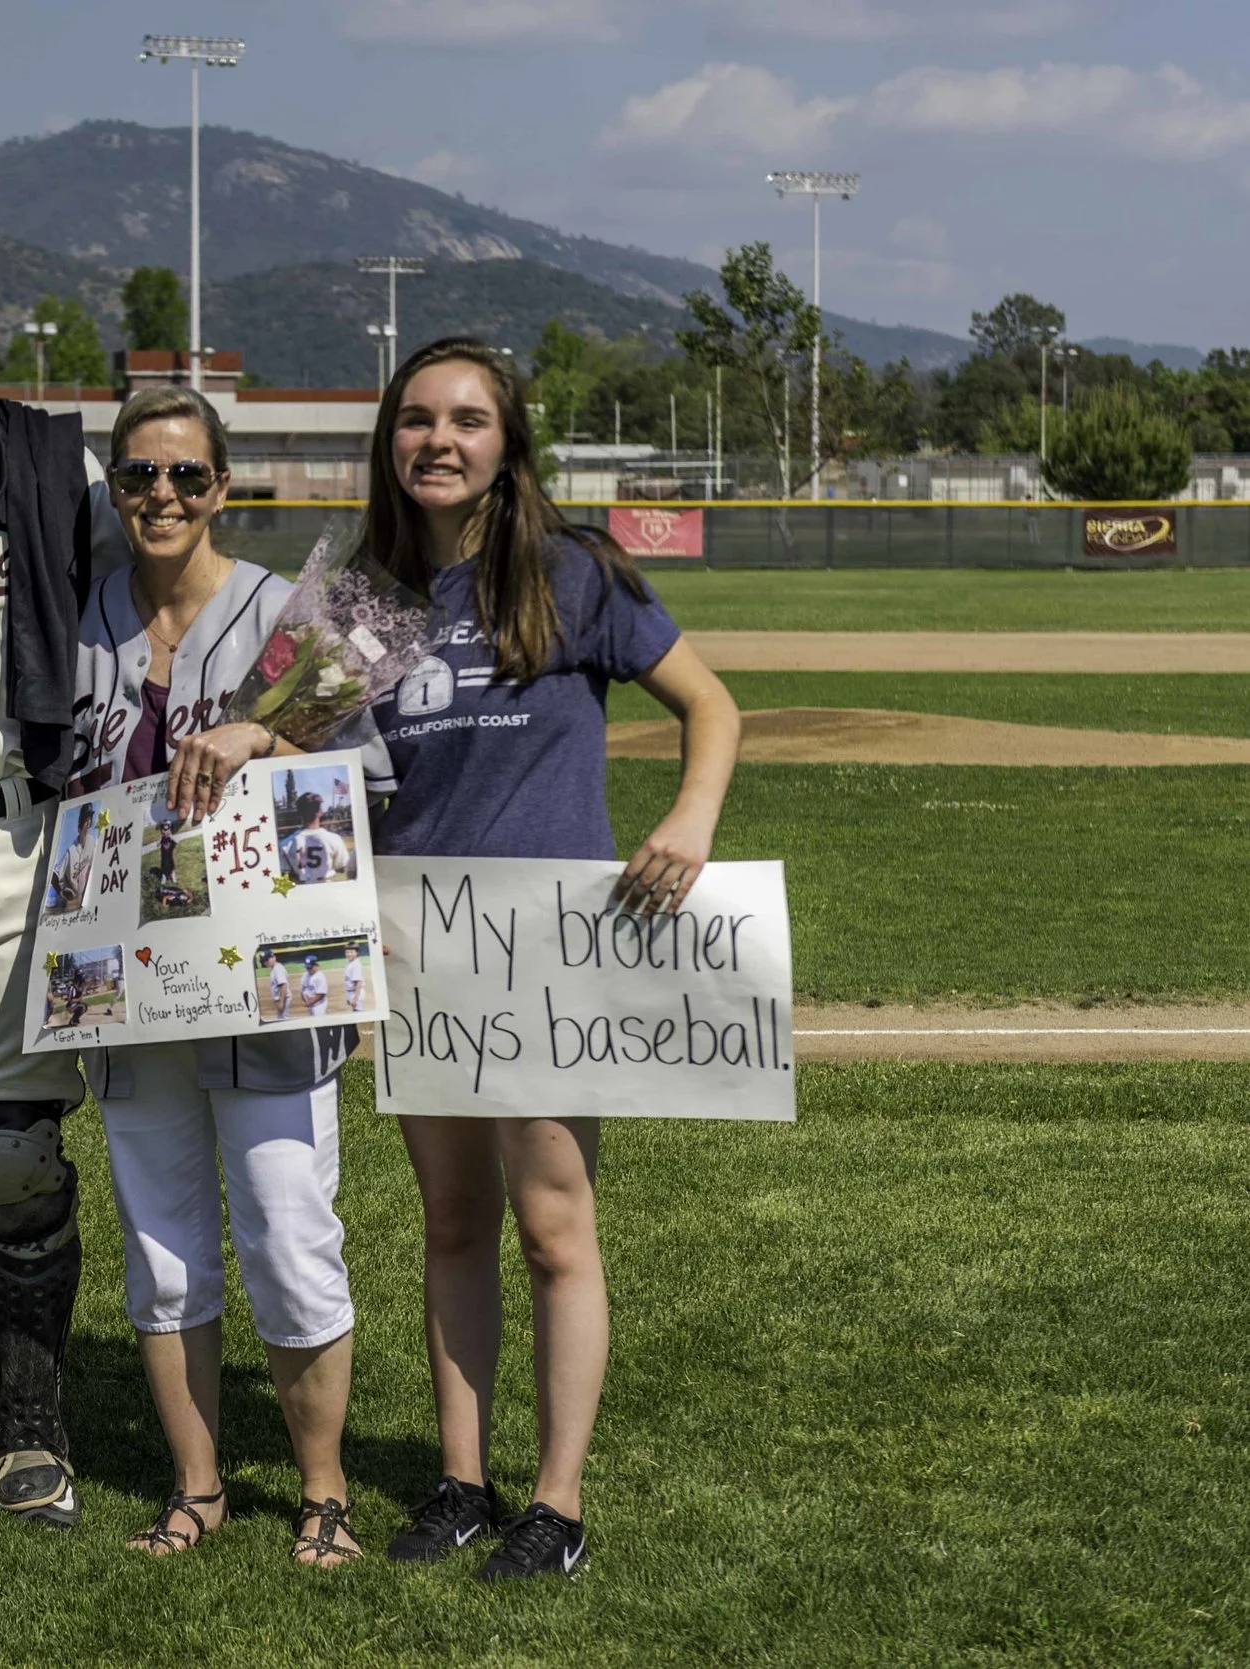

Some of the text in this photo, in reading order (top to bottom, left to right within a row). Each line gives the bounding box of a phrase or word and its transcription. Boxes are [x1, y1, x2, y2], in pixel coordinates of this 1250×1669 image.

[422, 682, 429, 706] 1
[399, 716, 476, 738] CALIFORNIA
[478, 713, 531, 727] COAST
[101, 821, 133, 854] HAVE
[212, 825, 261, 874] #15
[109, 846, 120, 868] A
[100, 868, 129, 895] DAY
[256, 932, 277, 943] The
[420, 873, 516, 991] My
[148, 954, 190, 977] Your
[162, 975, 212, 1001] Family
[138, 990, 258, 1025] (Your biggest fans!)
[380, 986, 791, 1097] plays baseball.
